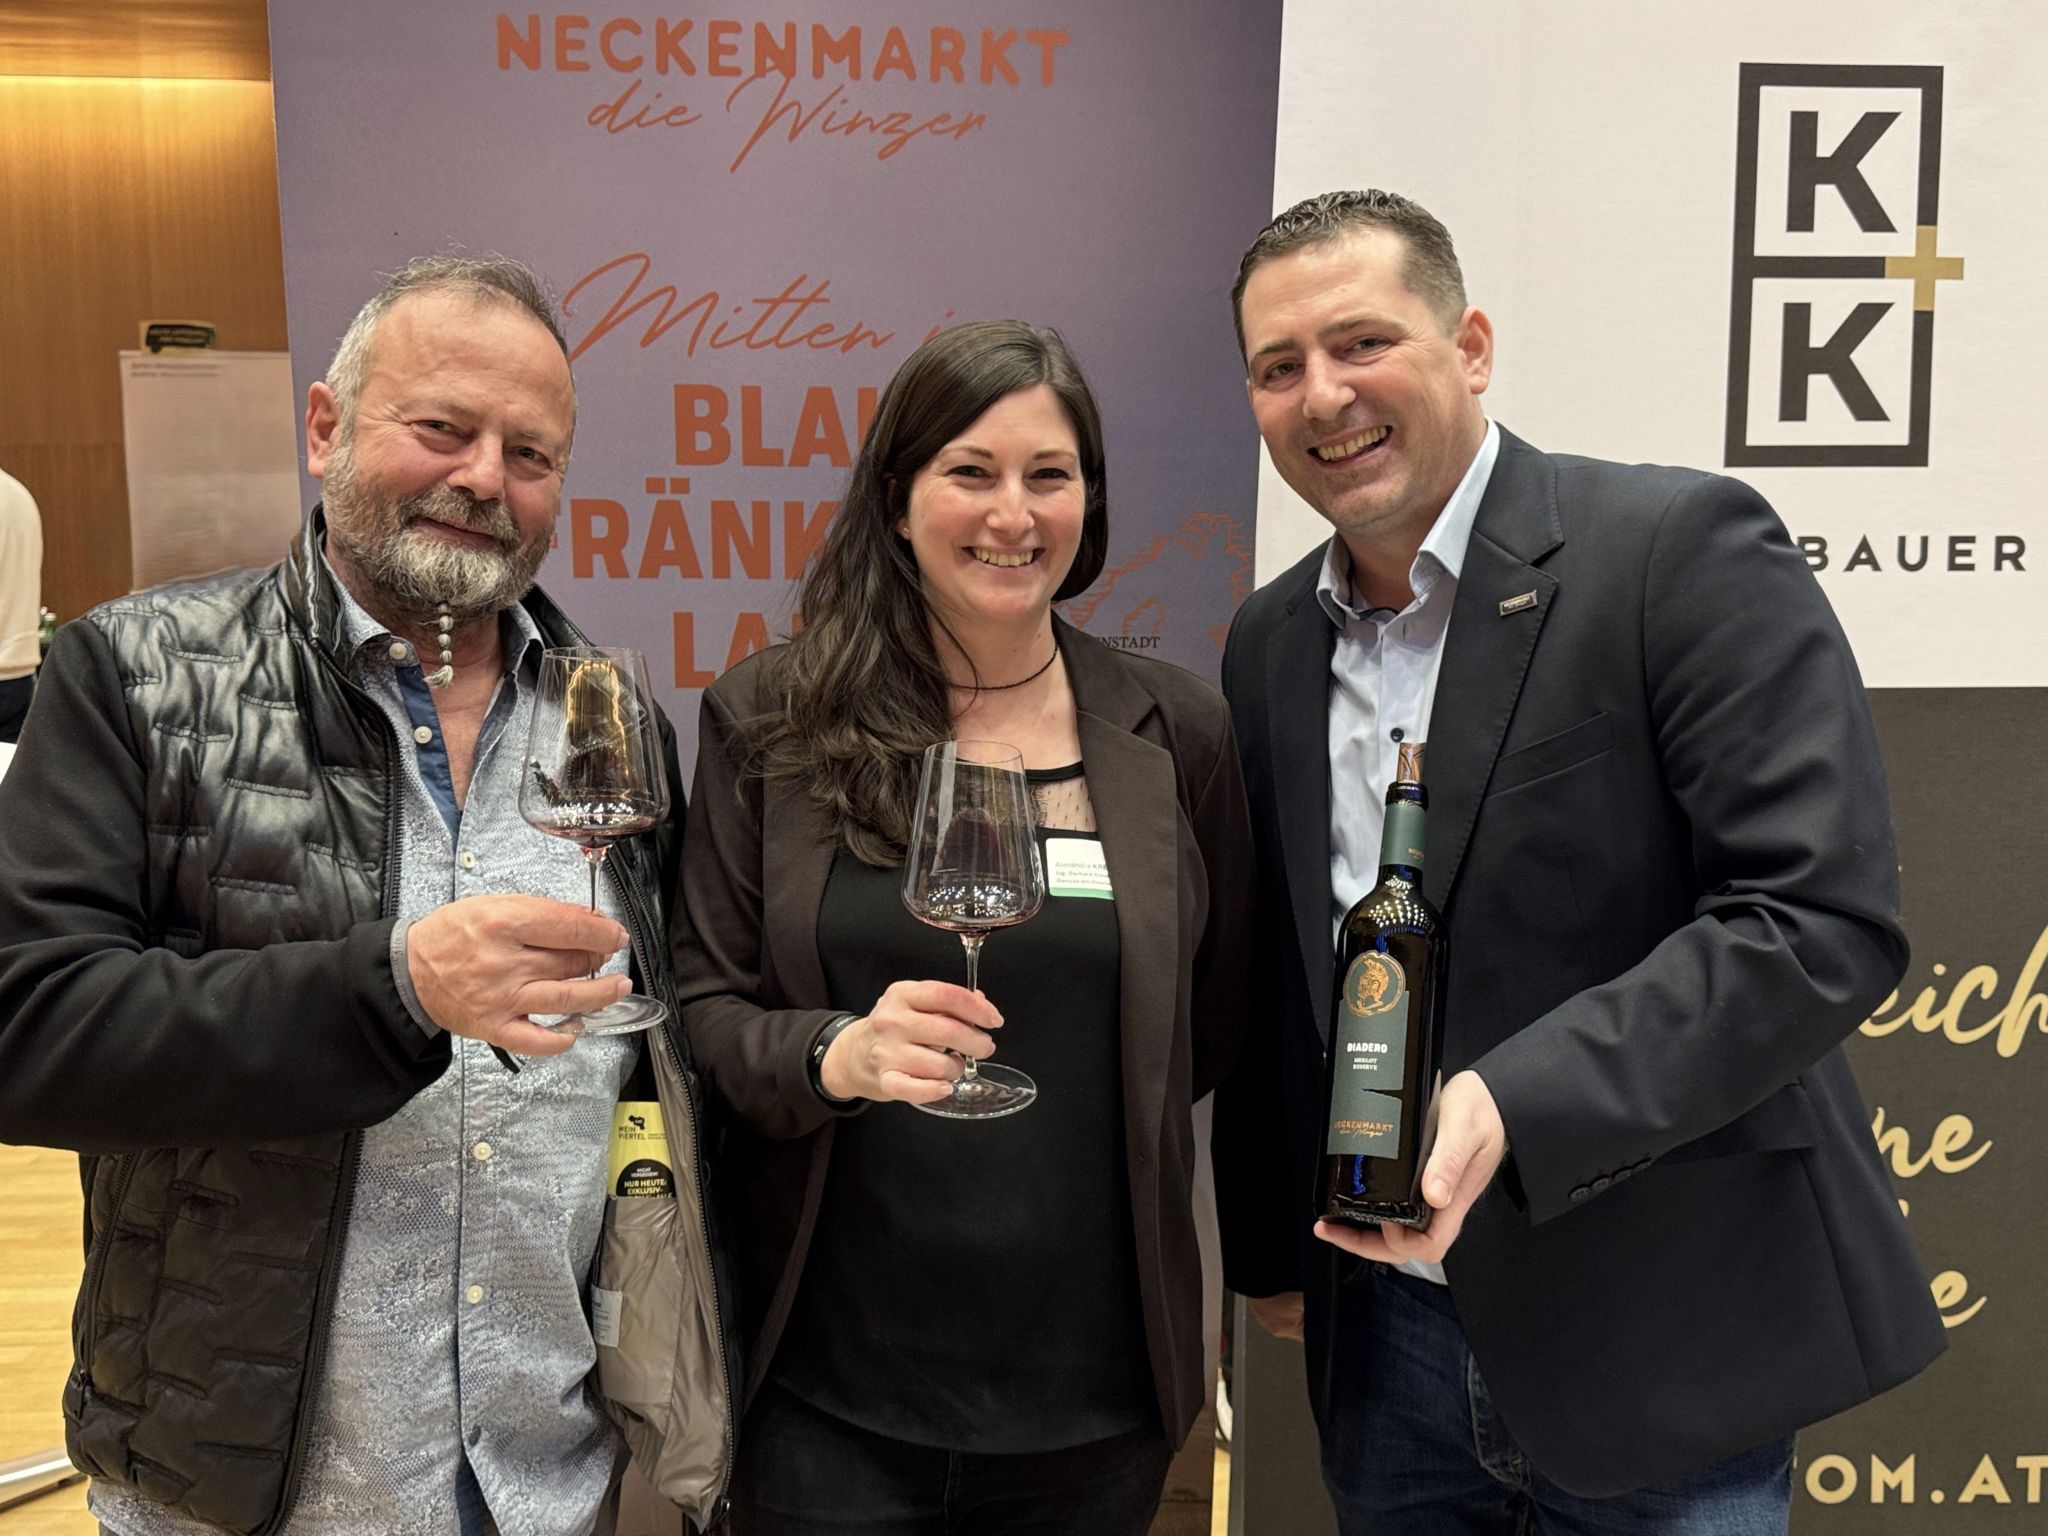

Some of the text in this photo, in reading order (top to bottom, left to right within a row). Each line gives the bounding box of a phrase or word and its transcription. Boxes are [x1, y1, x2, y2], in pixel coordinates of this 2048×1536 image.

[497, 14, 1072, 88] NECKENMARKT
[587, 62, 986, 174] die Winzer
[1785, 110, 1903, 234] K
[560, 253, 896, 362] Mitten
[1778, 302, 1896, 423] K
[552, 477, 838, 580] RÄNK
[1796, 533, 2027, 573] BAUER
[673, 611, 801, 689] LA
[624, 1180, 640, 1188] NUR
[1793, 1453, 2048, 1505] OM.AT
